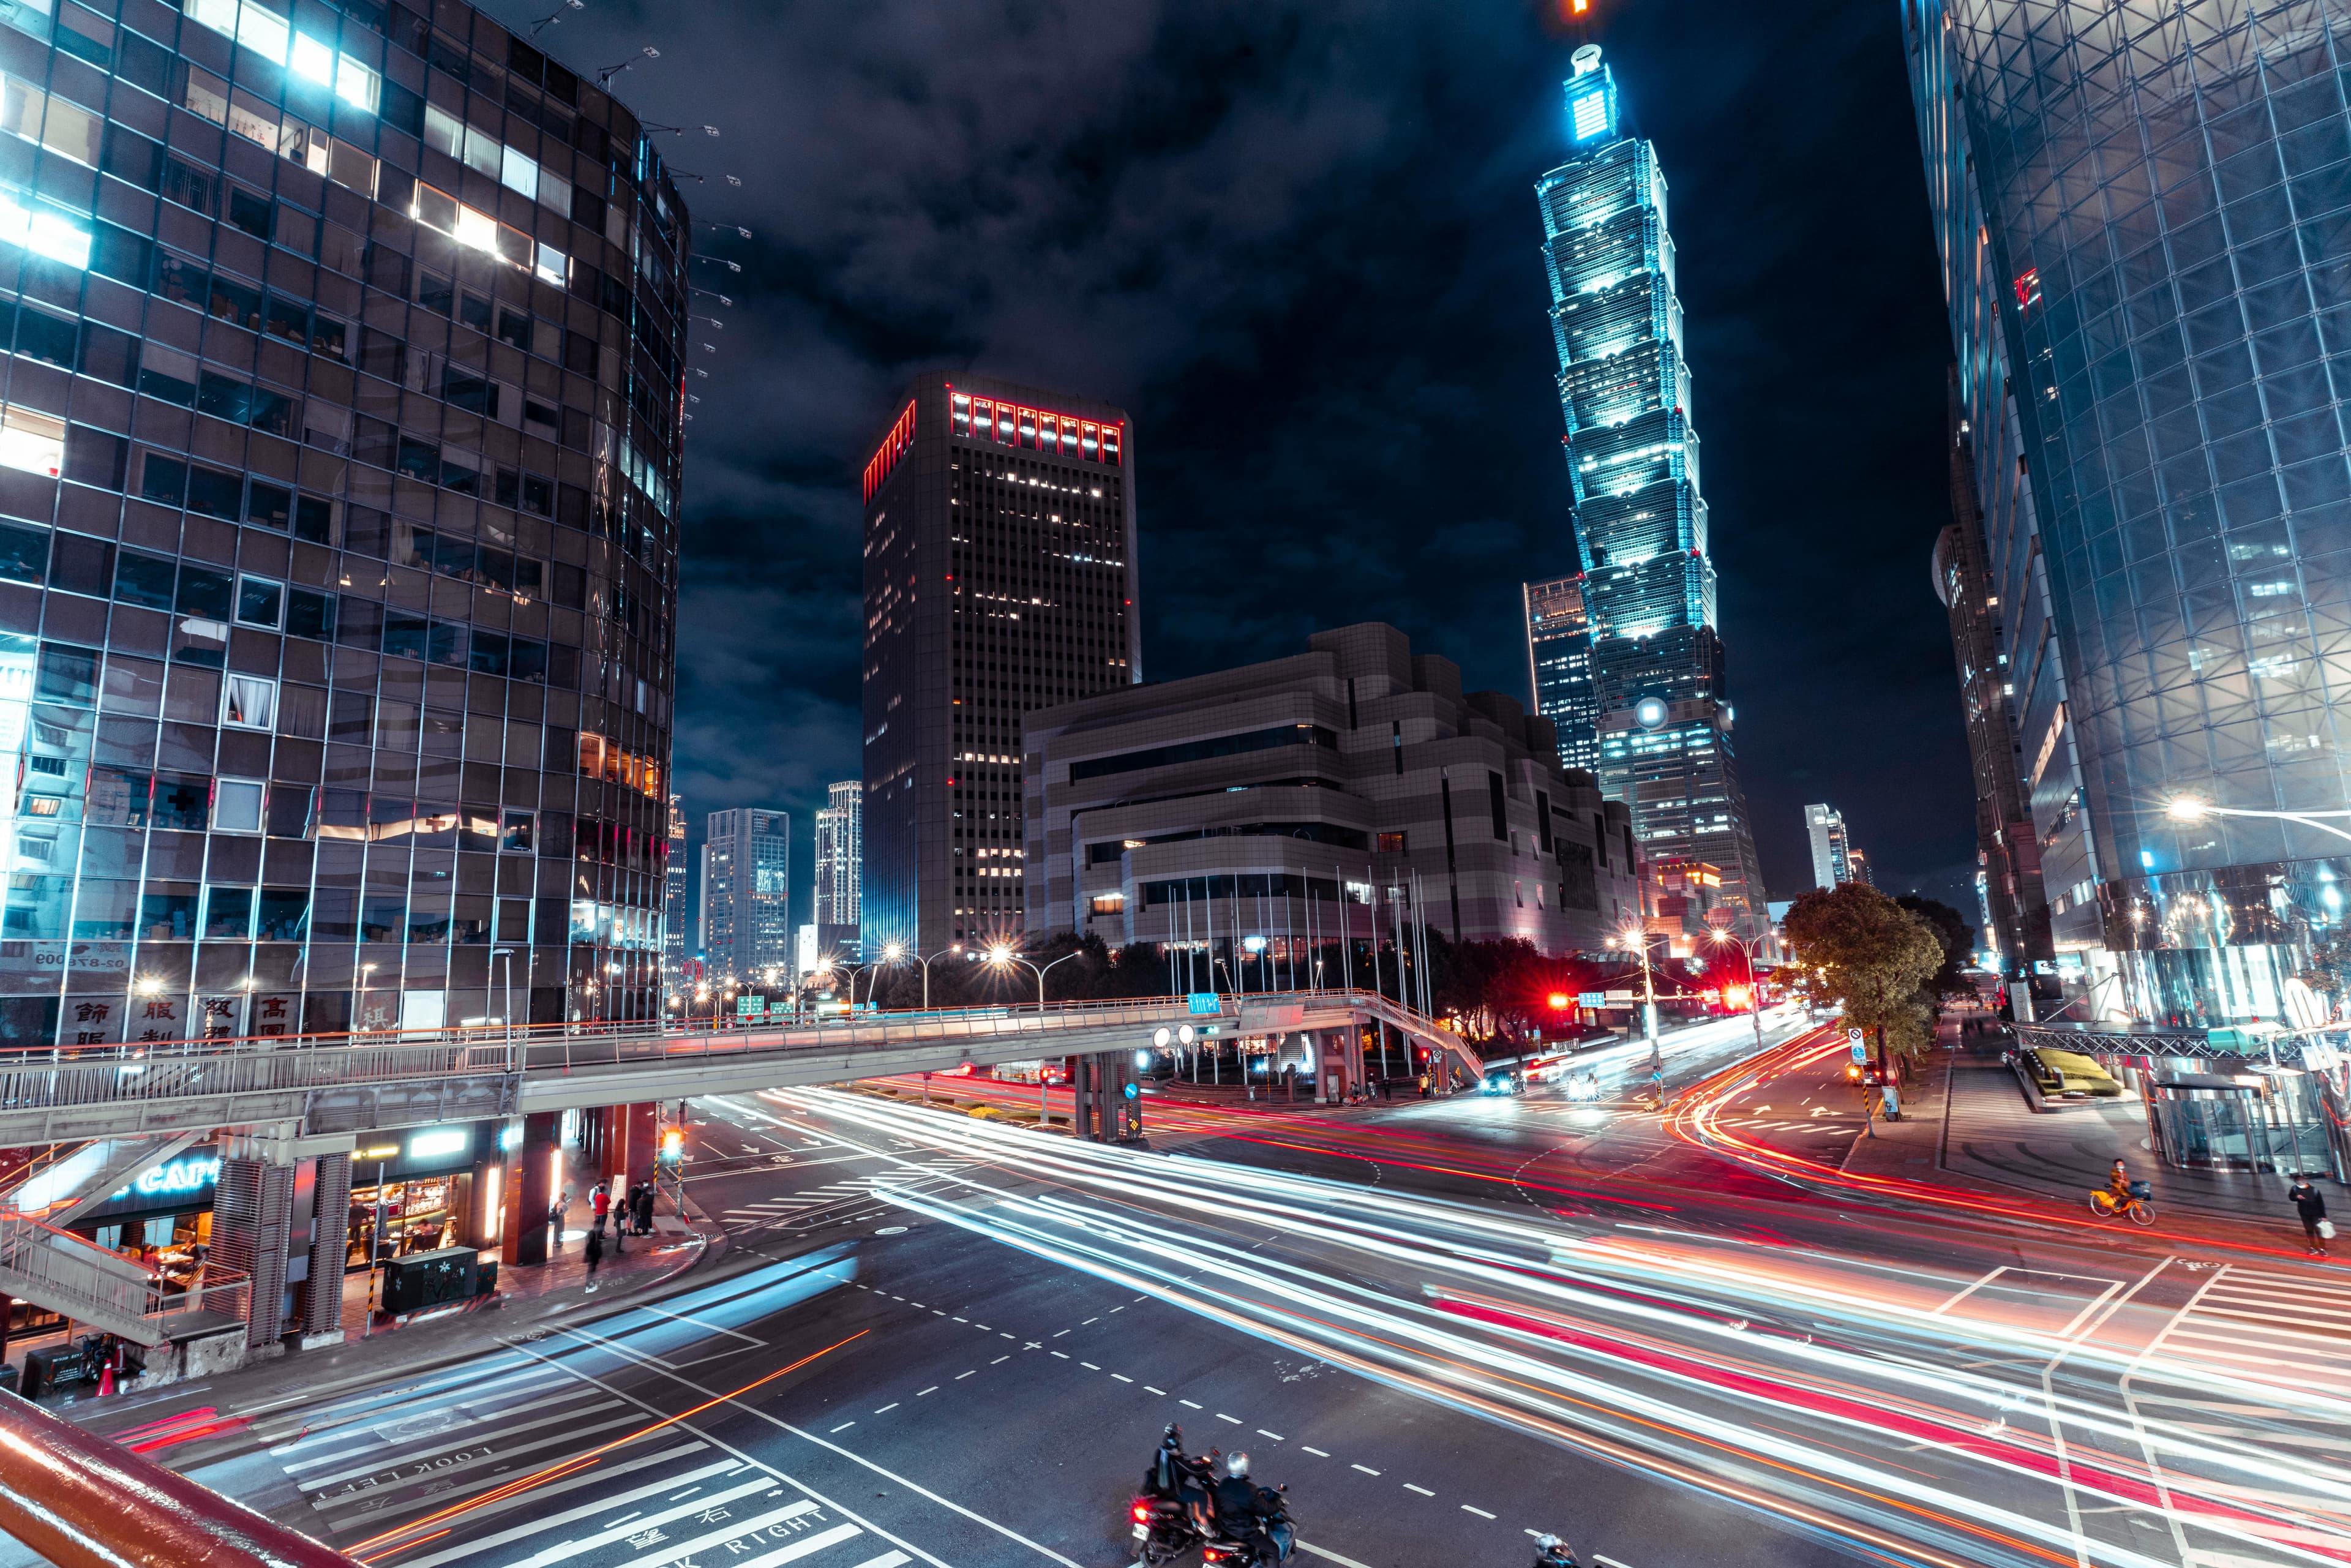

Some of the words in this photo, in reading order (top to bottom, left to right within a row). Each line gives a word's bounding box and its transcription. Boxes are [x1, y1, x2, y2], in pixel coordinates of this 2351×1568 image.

[414, 1447, 493, 1474] LOOK
[317, 1471, 400, 1501] LEFT
[624, 1506, 732, 1550] 望右
[724, 1509, 827, 1554] RIGHT
